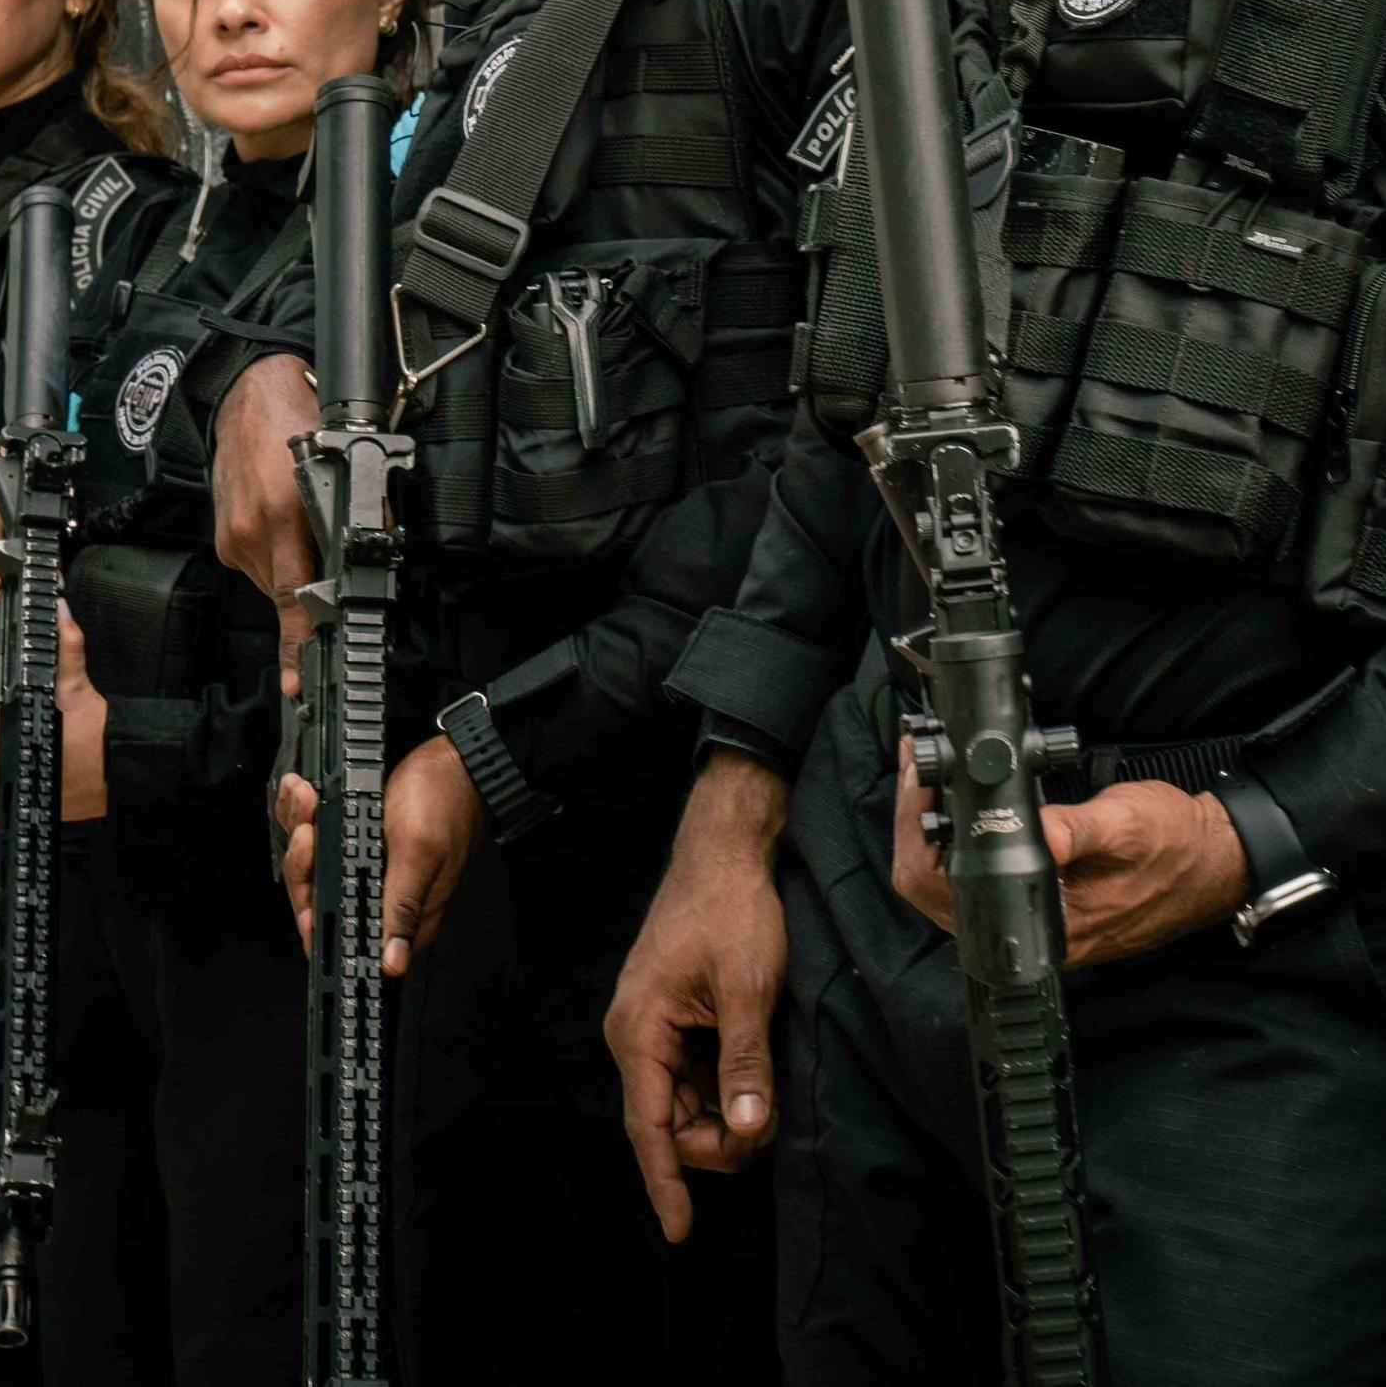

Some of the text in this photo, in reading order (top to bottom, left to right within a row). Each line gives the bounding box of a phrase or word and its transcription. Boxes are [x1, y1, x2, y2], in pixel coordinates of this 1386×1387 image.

[806, 86, 856, 157] POLÍC
[71, 176, 124, 290] OLICIA CIVIL
